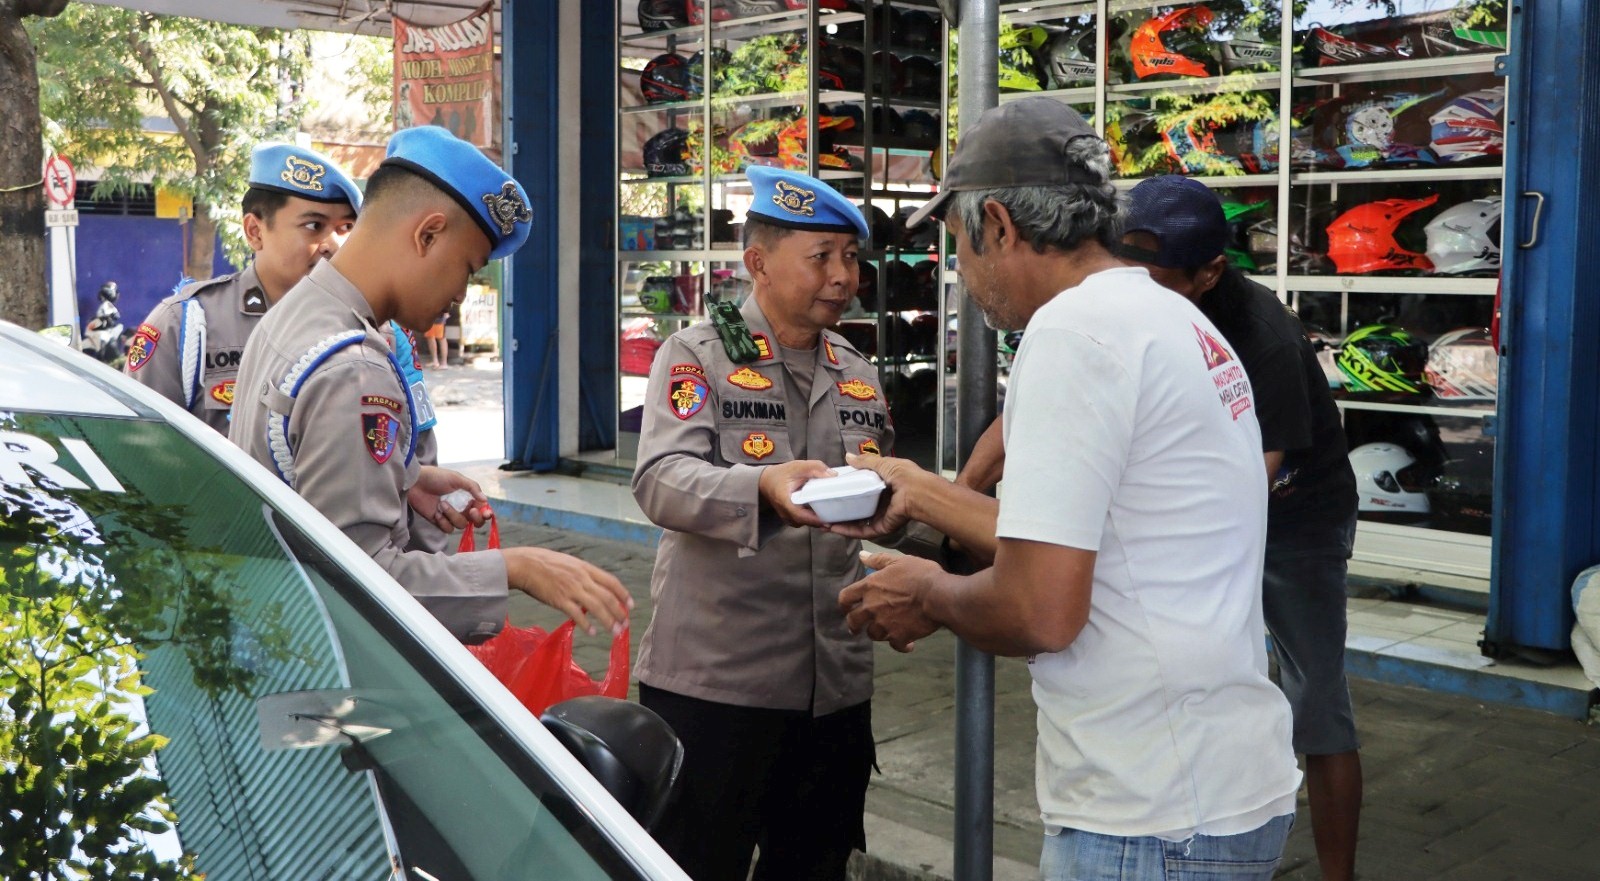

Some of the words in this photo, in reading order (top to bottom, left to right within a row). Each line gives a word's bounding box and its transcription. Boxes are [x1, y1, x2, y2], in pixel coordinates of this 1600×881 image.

[402, 26, 436, 53] JAS
[402, 59, 445, 79] MODEL
[206, 351, 244, 368] LOR
[722, 401, 786, 420] SUKIMAN
[839, 409, 885, 430] POLRI
